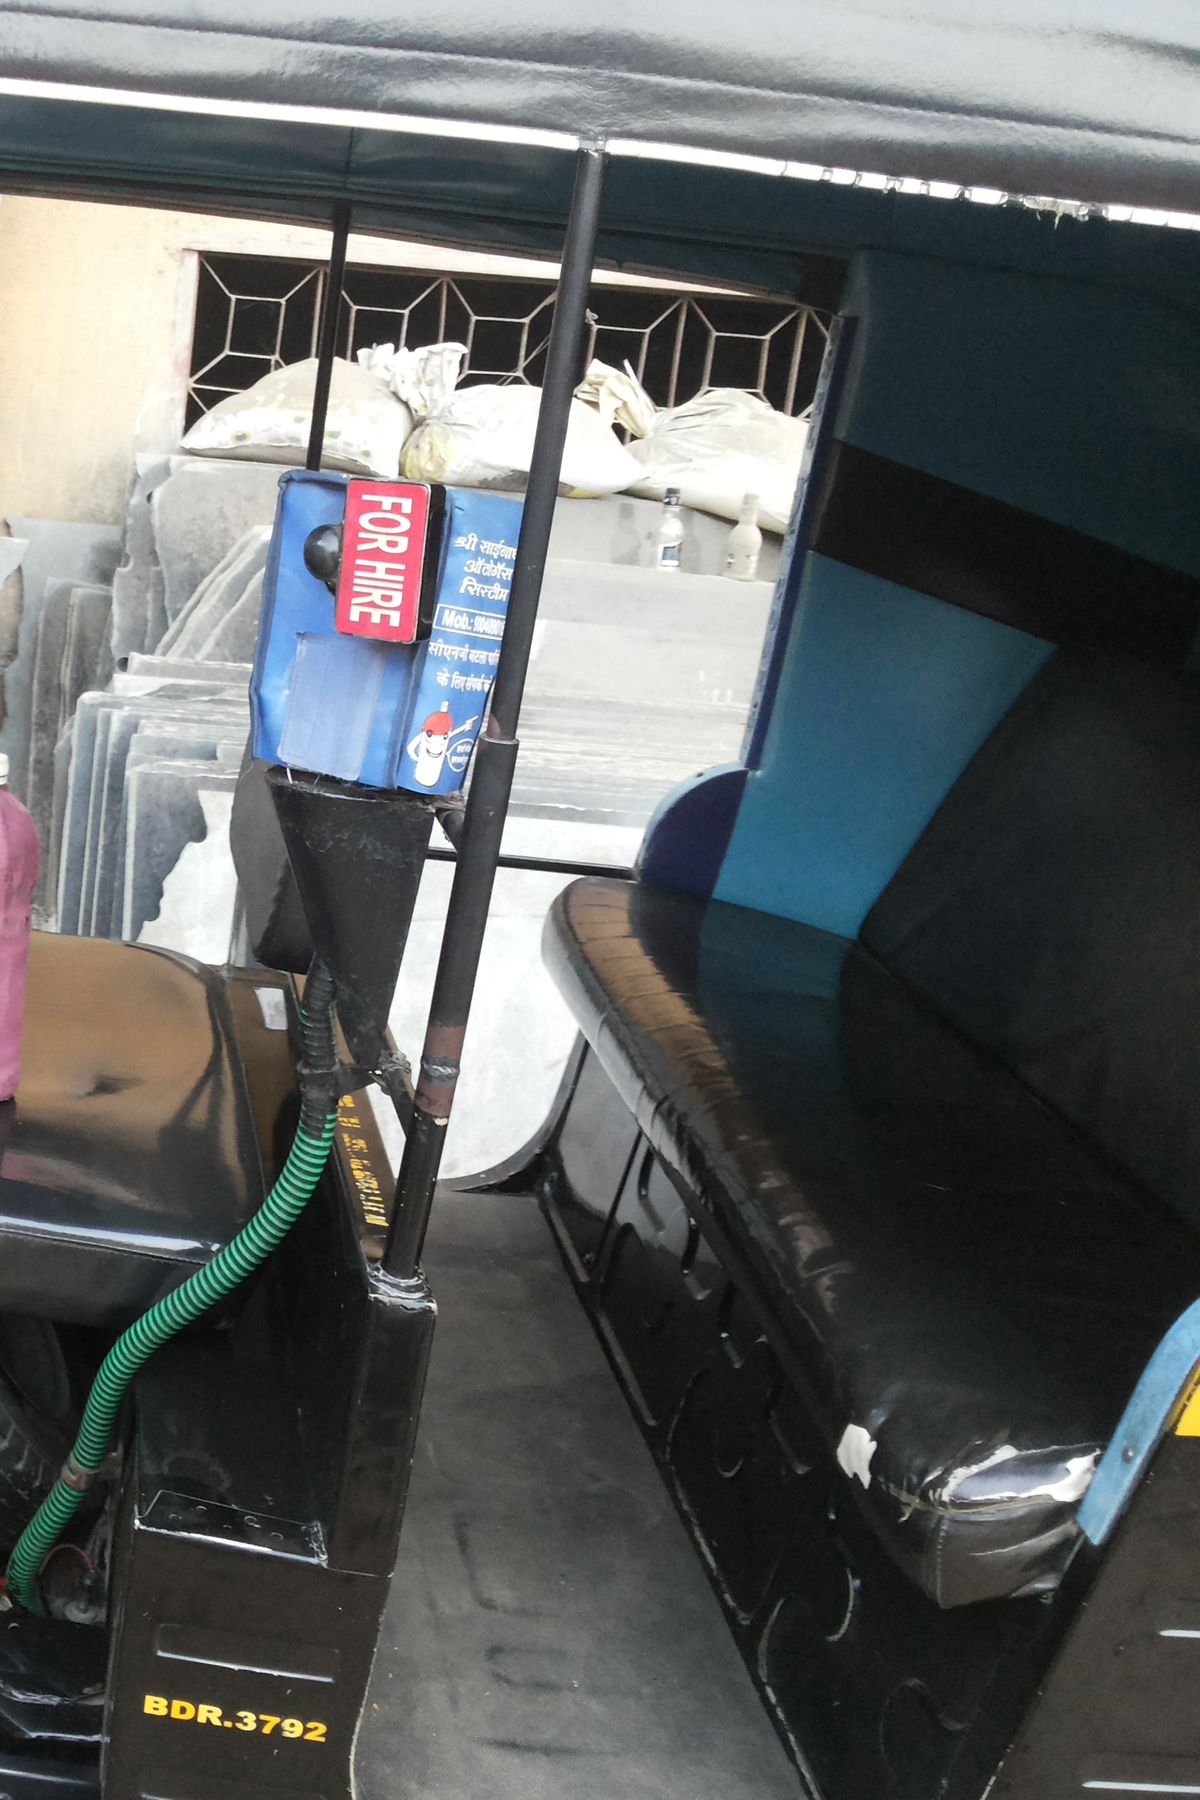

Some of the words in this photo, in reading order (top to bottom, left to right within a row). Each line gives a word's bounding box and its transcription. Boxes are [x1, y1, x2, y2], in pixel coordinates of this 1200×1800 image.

[356, 494, 413, 555] FOR
[454, 533, 479, 551] श्री
[349, 559, 406, 628] HIRE
[143, 1695, 328, 1743] BDR.3792
